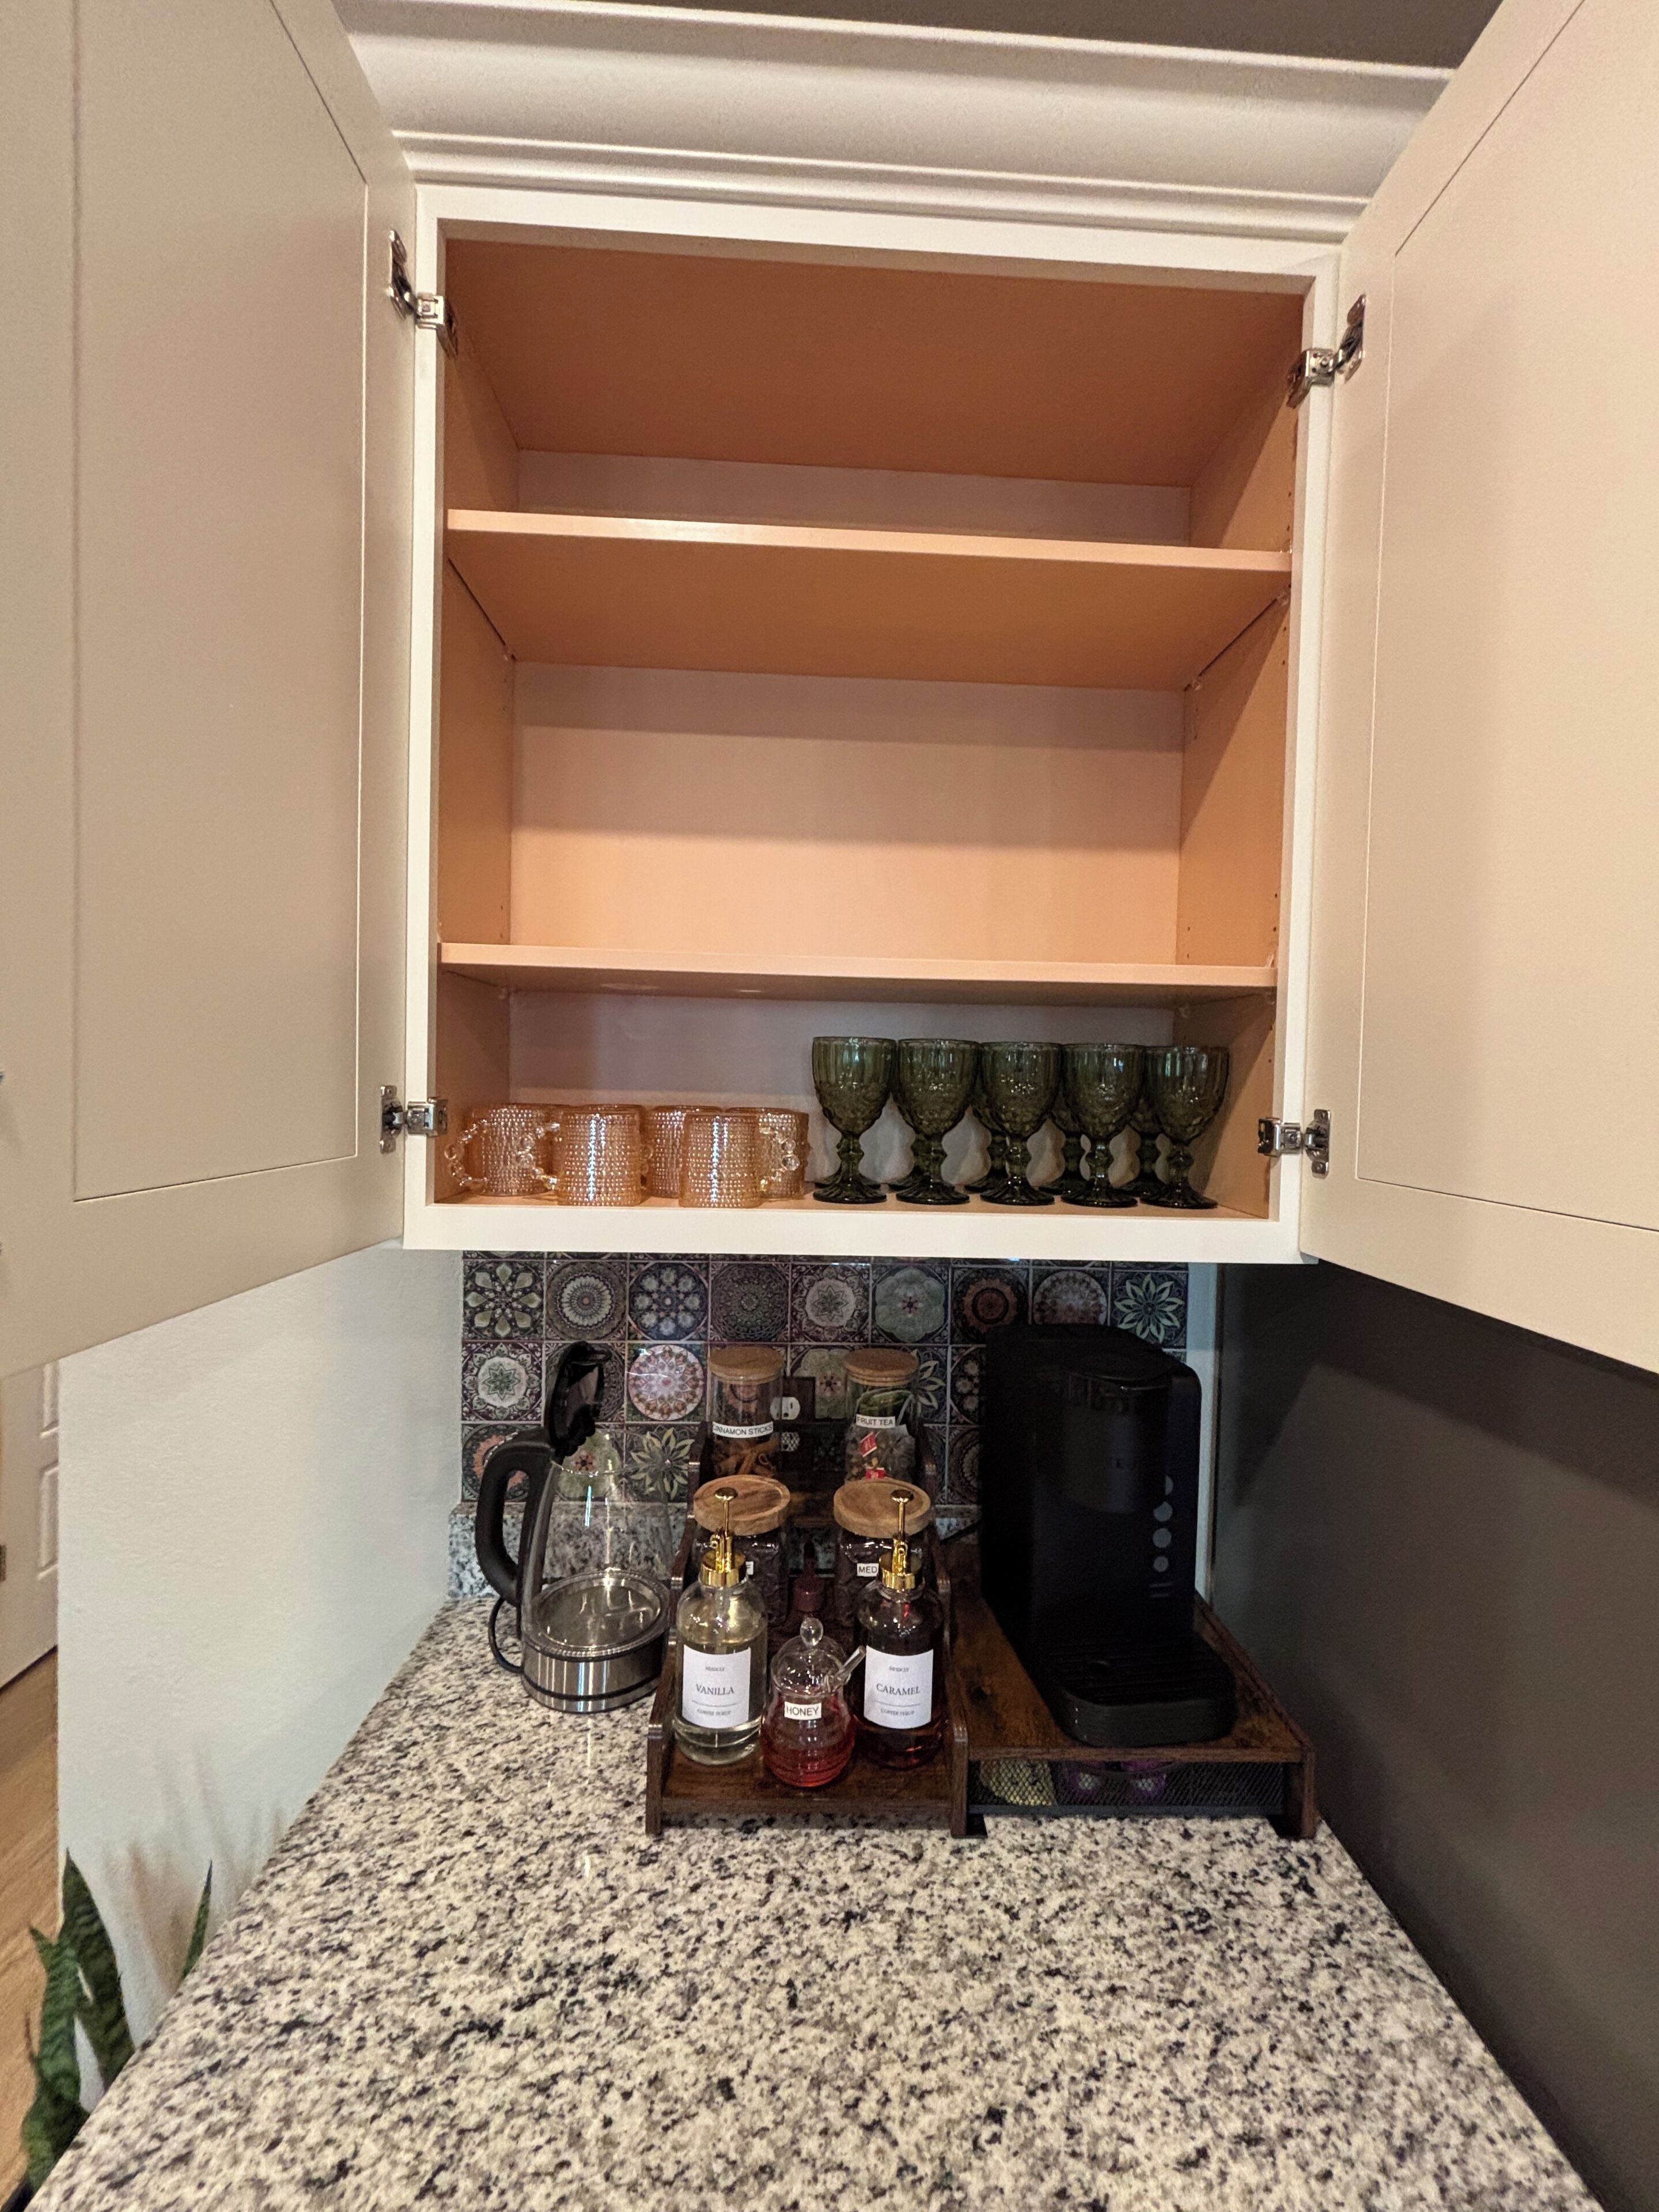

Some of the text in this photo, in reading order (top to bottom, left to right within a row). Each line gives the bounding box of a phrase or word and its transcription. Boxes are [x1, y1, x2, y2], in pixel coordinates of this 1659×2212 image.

[857, 1417, 876, 1426] FRUIT
[749, 1423, 772, 1435] STICKS
[858, 1566, 877, 1574] MED
[696, 1684, 734, 1696] VANILLA
[876, 1683, 921, 1696] CARAMEL
[786, 1705, 819, 1717] HONEY
